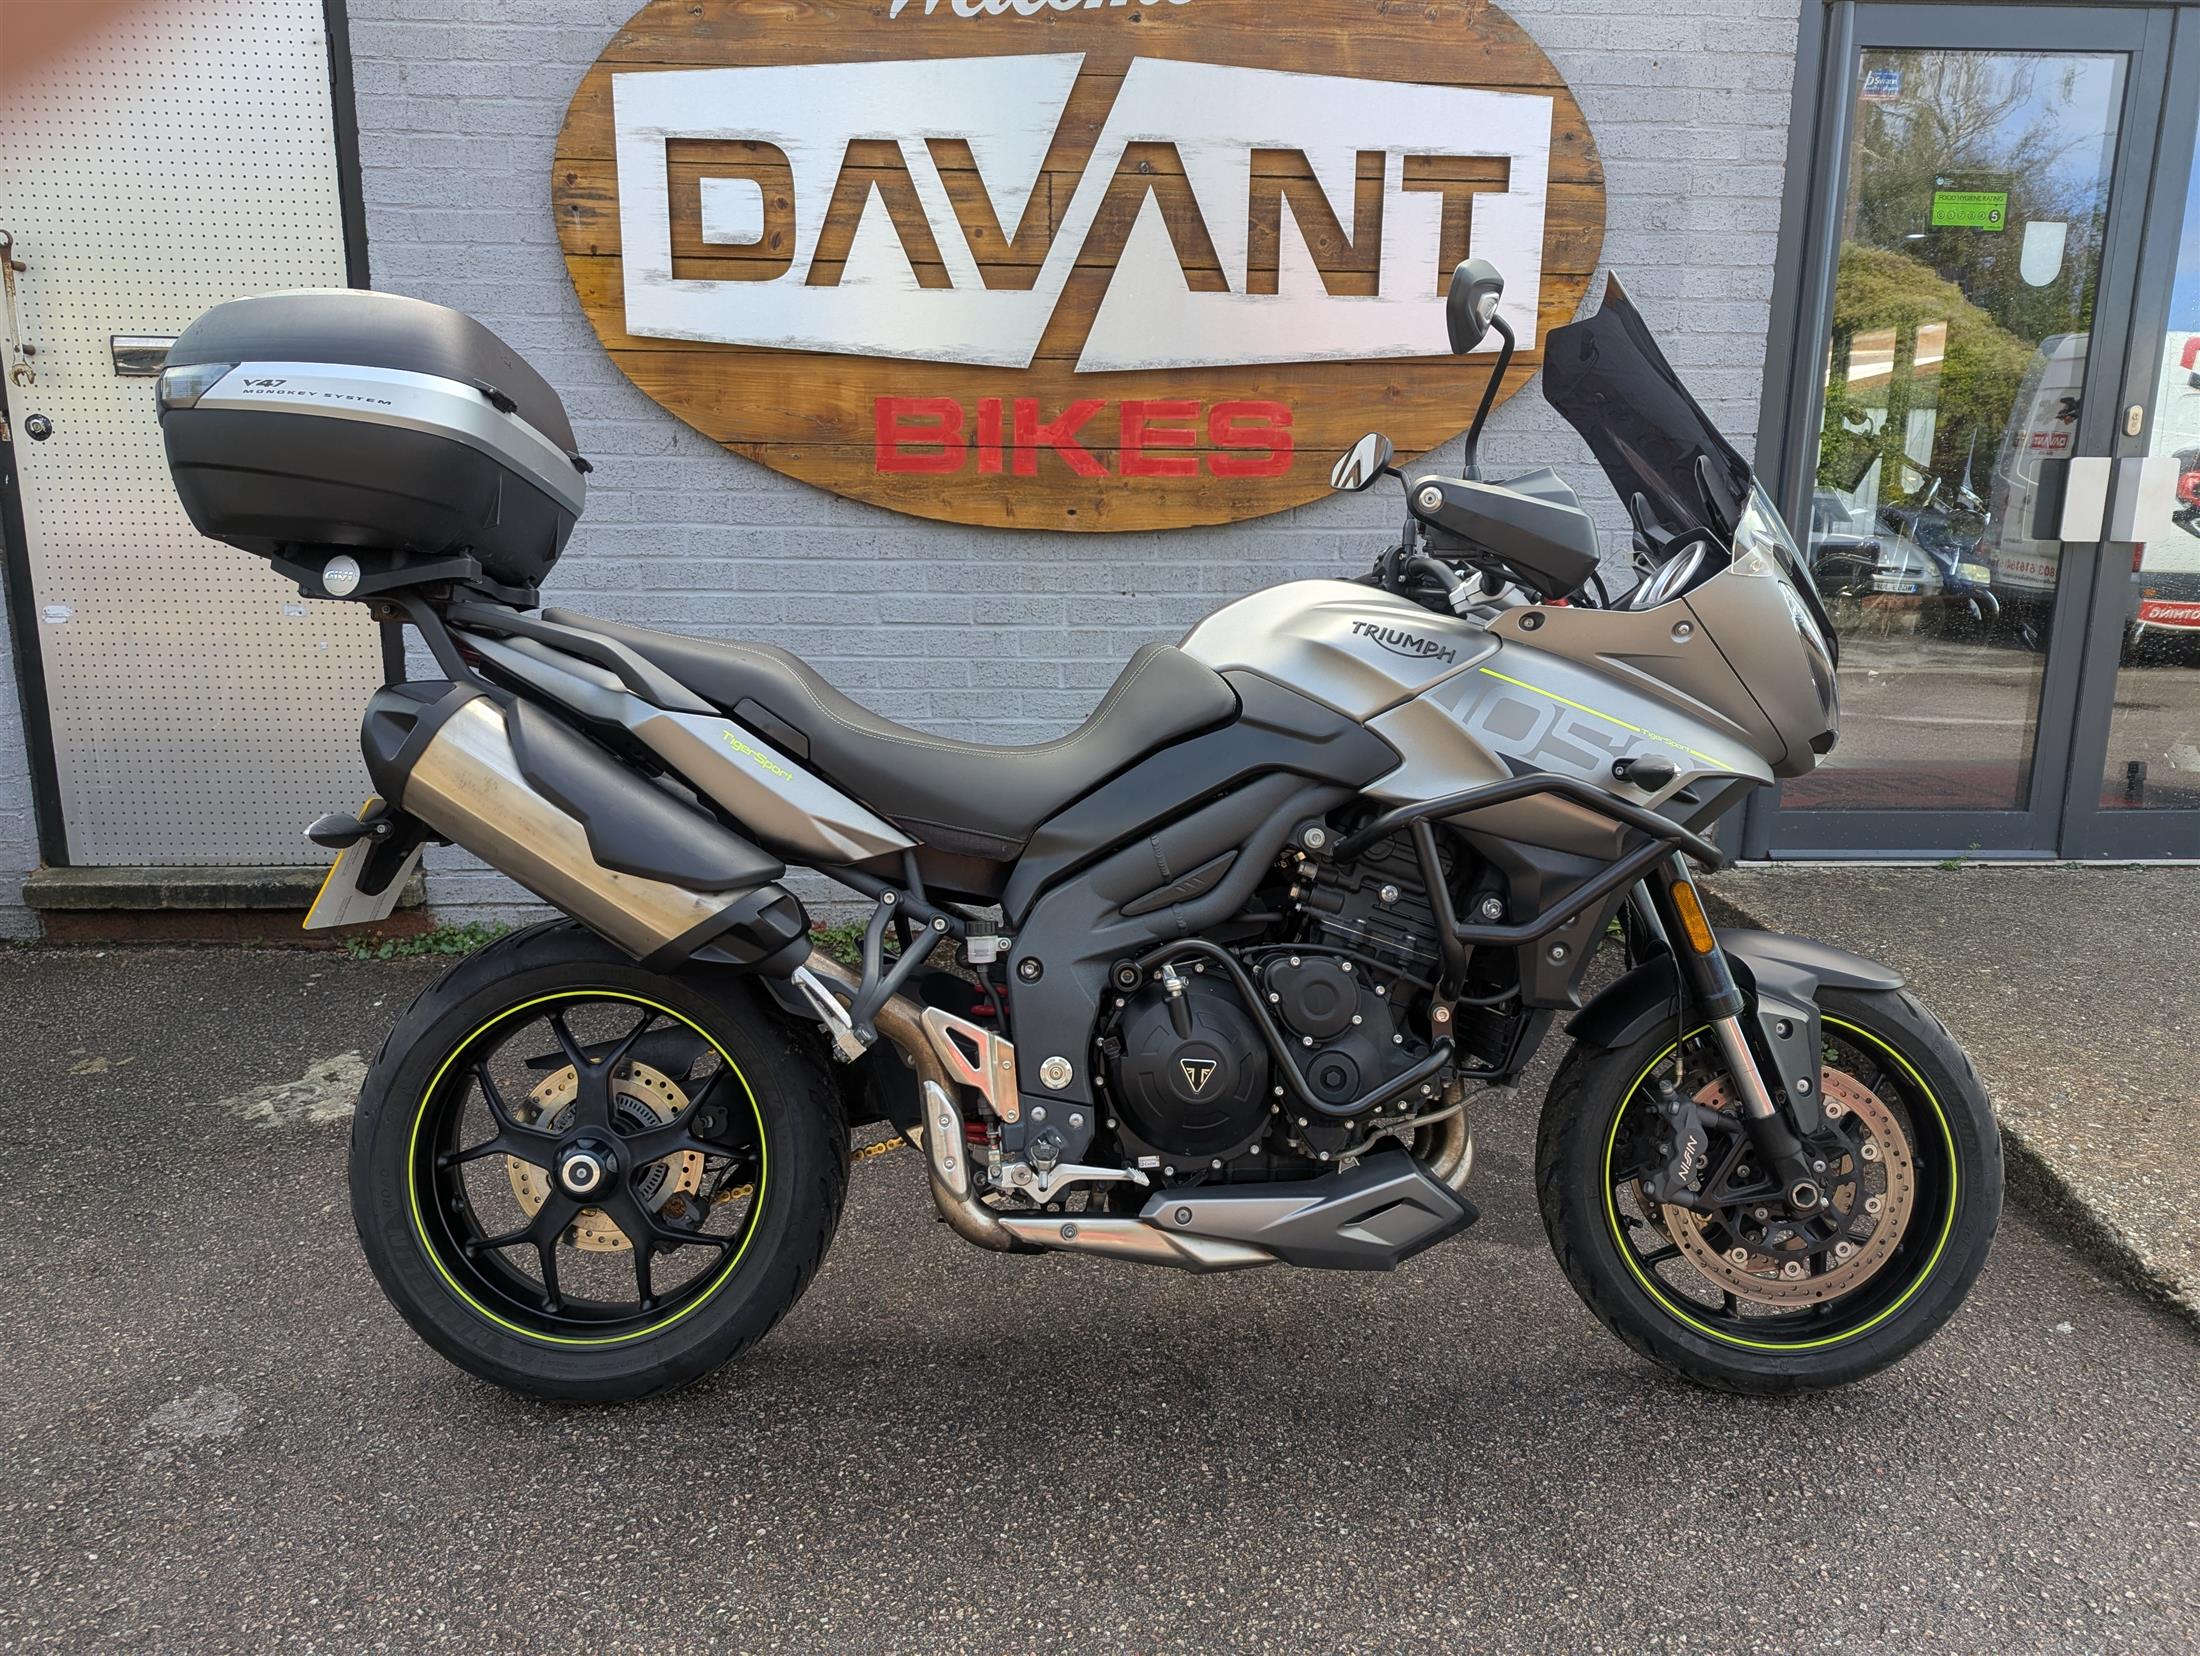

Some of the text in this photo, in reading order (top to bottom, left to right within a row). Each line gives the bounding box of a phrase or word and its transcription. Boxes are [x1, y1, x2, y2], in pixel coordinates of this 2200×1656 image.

[664, 136, 1511, 298] DAVANT
[243, 379, 287, 388] V47
[323, 393, 392, 406] SYSTEM
[873, 395, 1295, 478] BIKES
[1351, 620, 1457, 664] TRIUMPH
[722, 729, 794, 781] TigerSport
[1677, 1134, 1698, 1182] NISSIN
